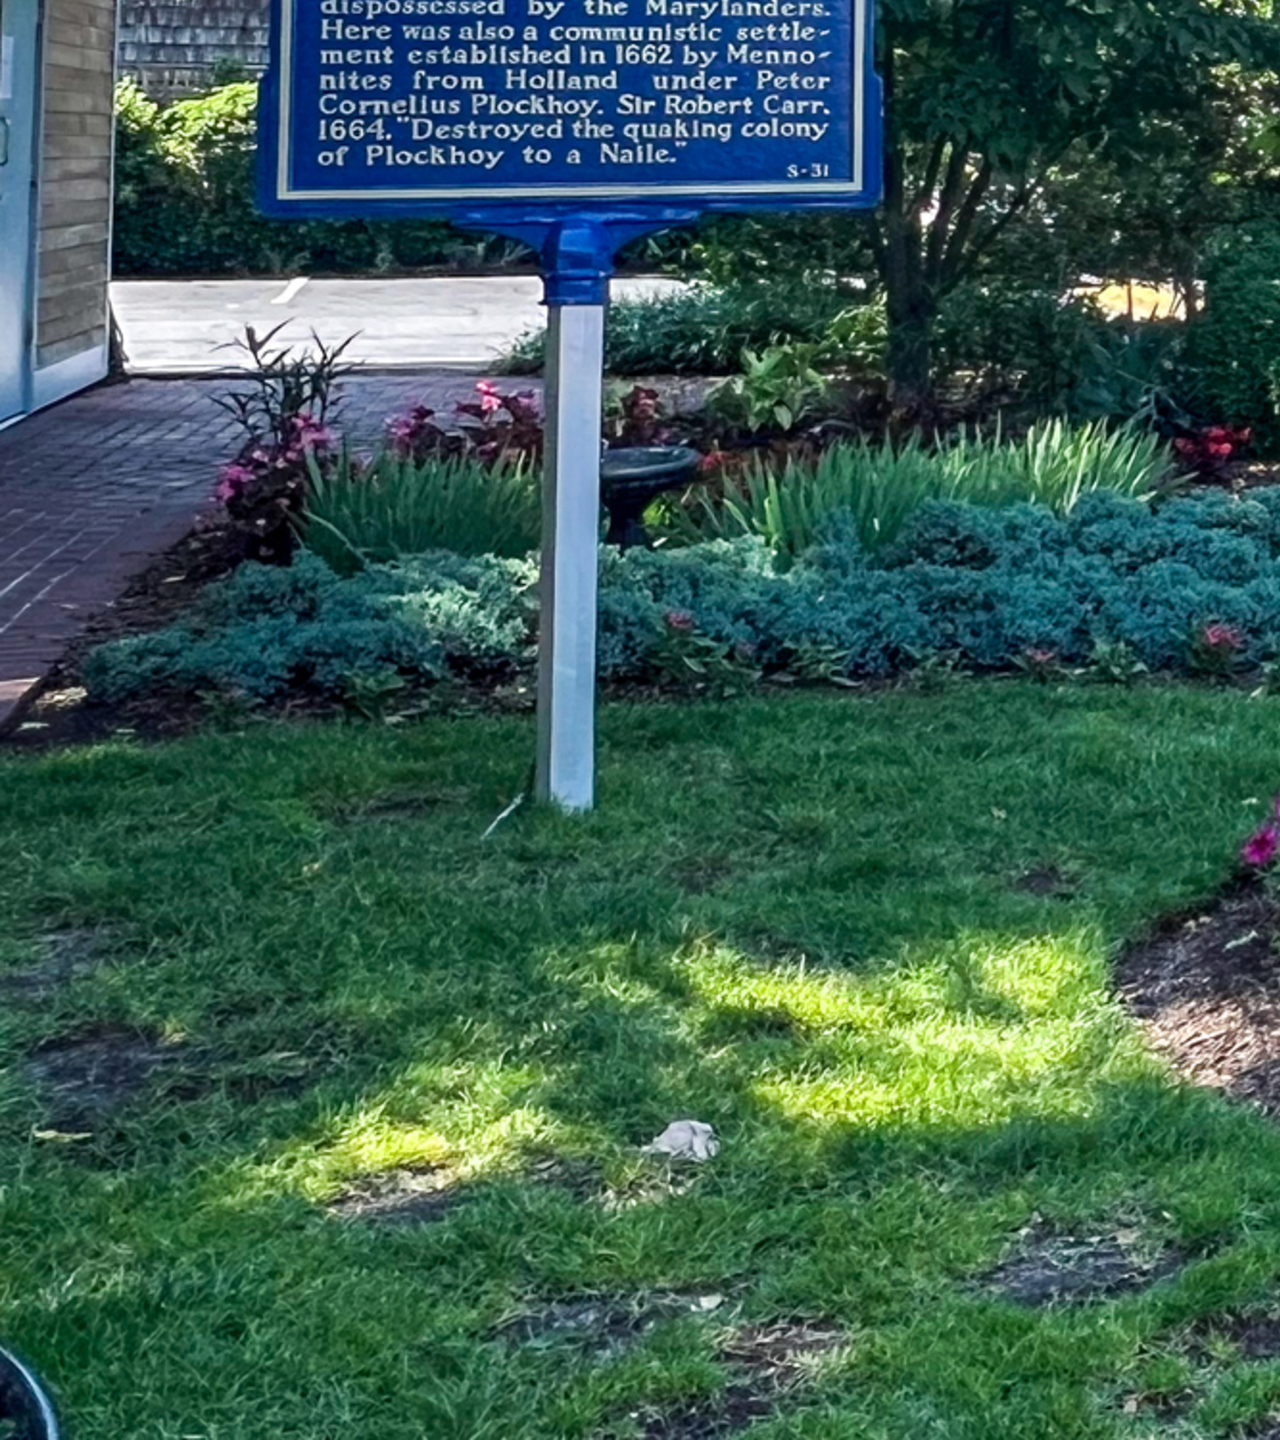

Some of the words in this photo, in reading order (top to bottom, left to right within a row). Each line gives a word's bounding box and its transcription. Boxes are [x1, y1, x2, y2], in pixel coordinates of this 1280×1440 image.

[321, 18, 392, 40] Here
[402, 25, 451, 41] was
[458, 20, 515, 41] also
[523, 25, 538, 41] a
[549, 22, 722, 42] communistic
[736, 20, 830, 41] settle-
[320, 46, 394, 64] ment
[408, 43, 571, 65] established
[580, 45, 606, 65] in
[615, 43, 673, 65] 1662
[682, 44, 718, 69] by
[727, 43, 831, 65] Menno-
[320, 71, 392, 91] nites
[413, 69, 484, 90] from
[505, 68, 618, 91] Holland
[653, 70, 738, 91] under
[756, 69, 831, 90] Peter
[319, 93, 461, 116] Cornelius
[616, 93, 656, 115] Sir
[664, 94, 754, 115] Robert
[571, 118, 614, 139] the
[623, 118, 732, 143] quaking
[740, 117, 829, 142] colony
[317, 146, 349, 166] of
[366, 144, 504, 169] Plockhoy
[522, 145, 552, 164] to
[566, 149, 581, 164] a
[600, 140, 687, 164] Naile."
[787, 163, 829, 178] S-31
